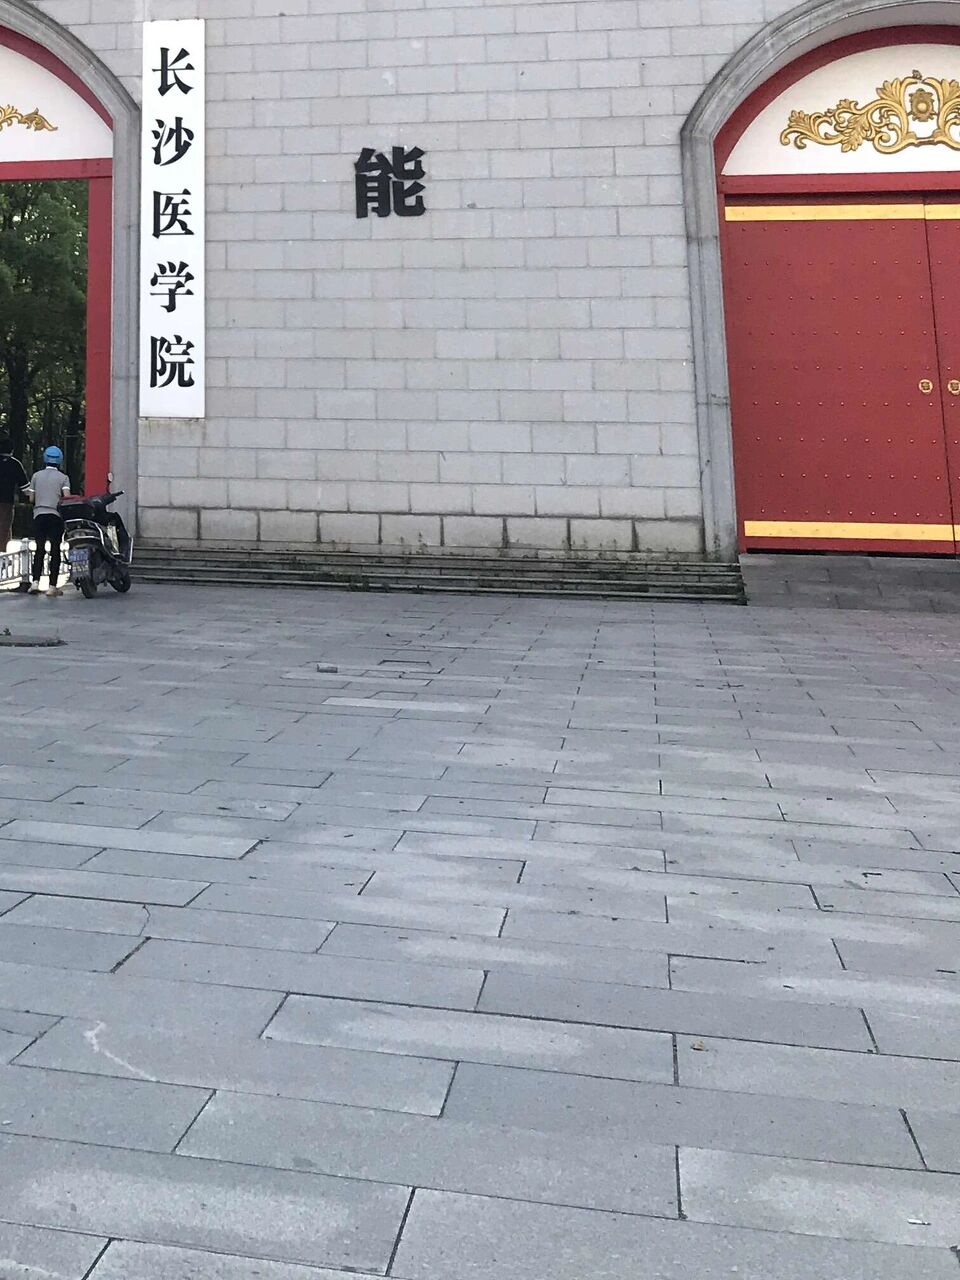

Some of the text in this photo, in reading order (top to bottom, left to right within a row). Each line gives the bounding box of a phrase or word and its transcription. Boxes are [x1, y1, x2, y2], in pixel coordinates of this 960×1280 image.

[149, 47, 195, 389] 长沙医学院
